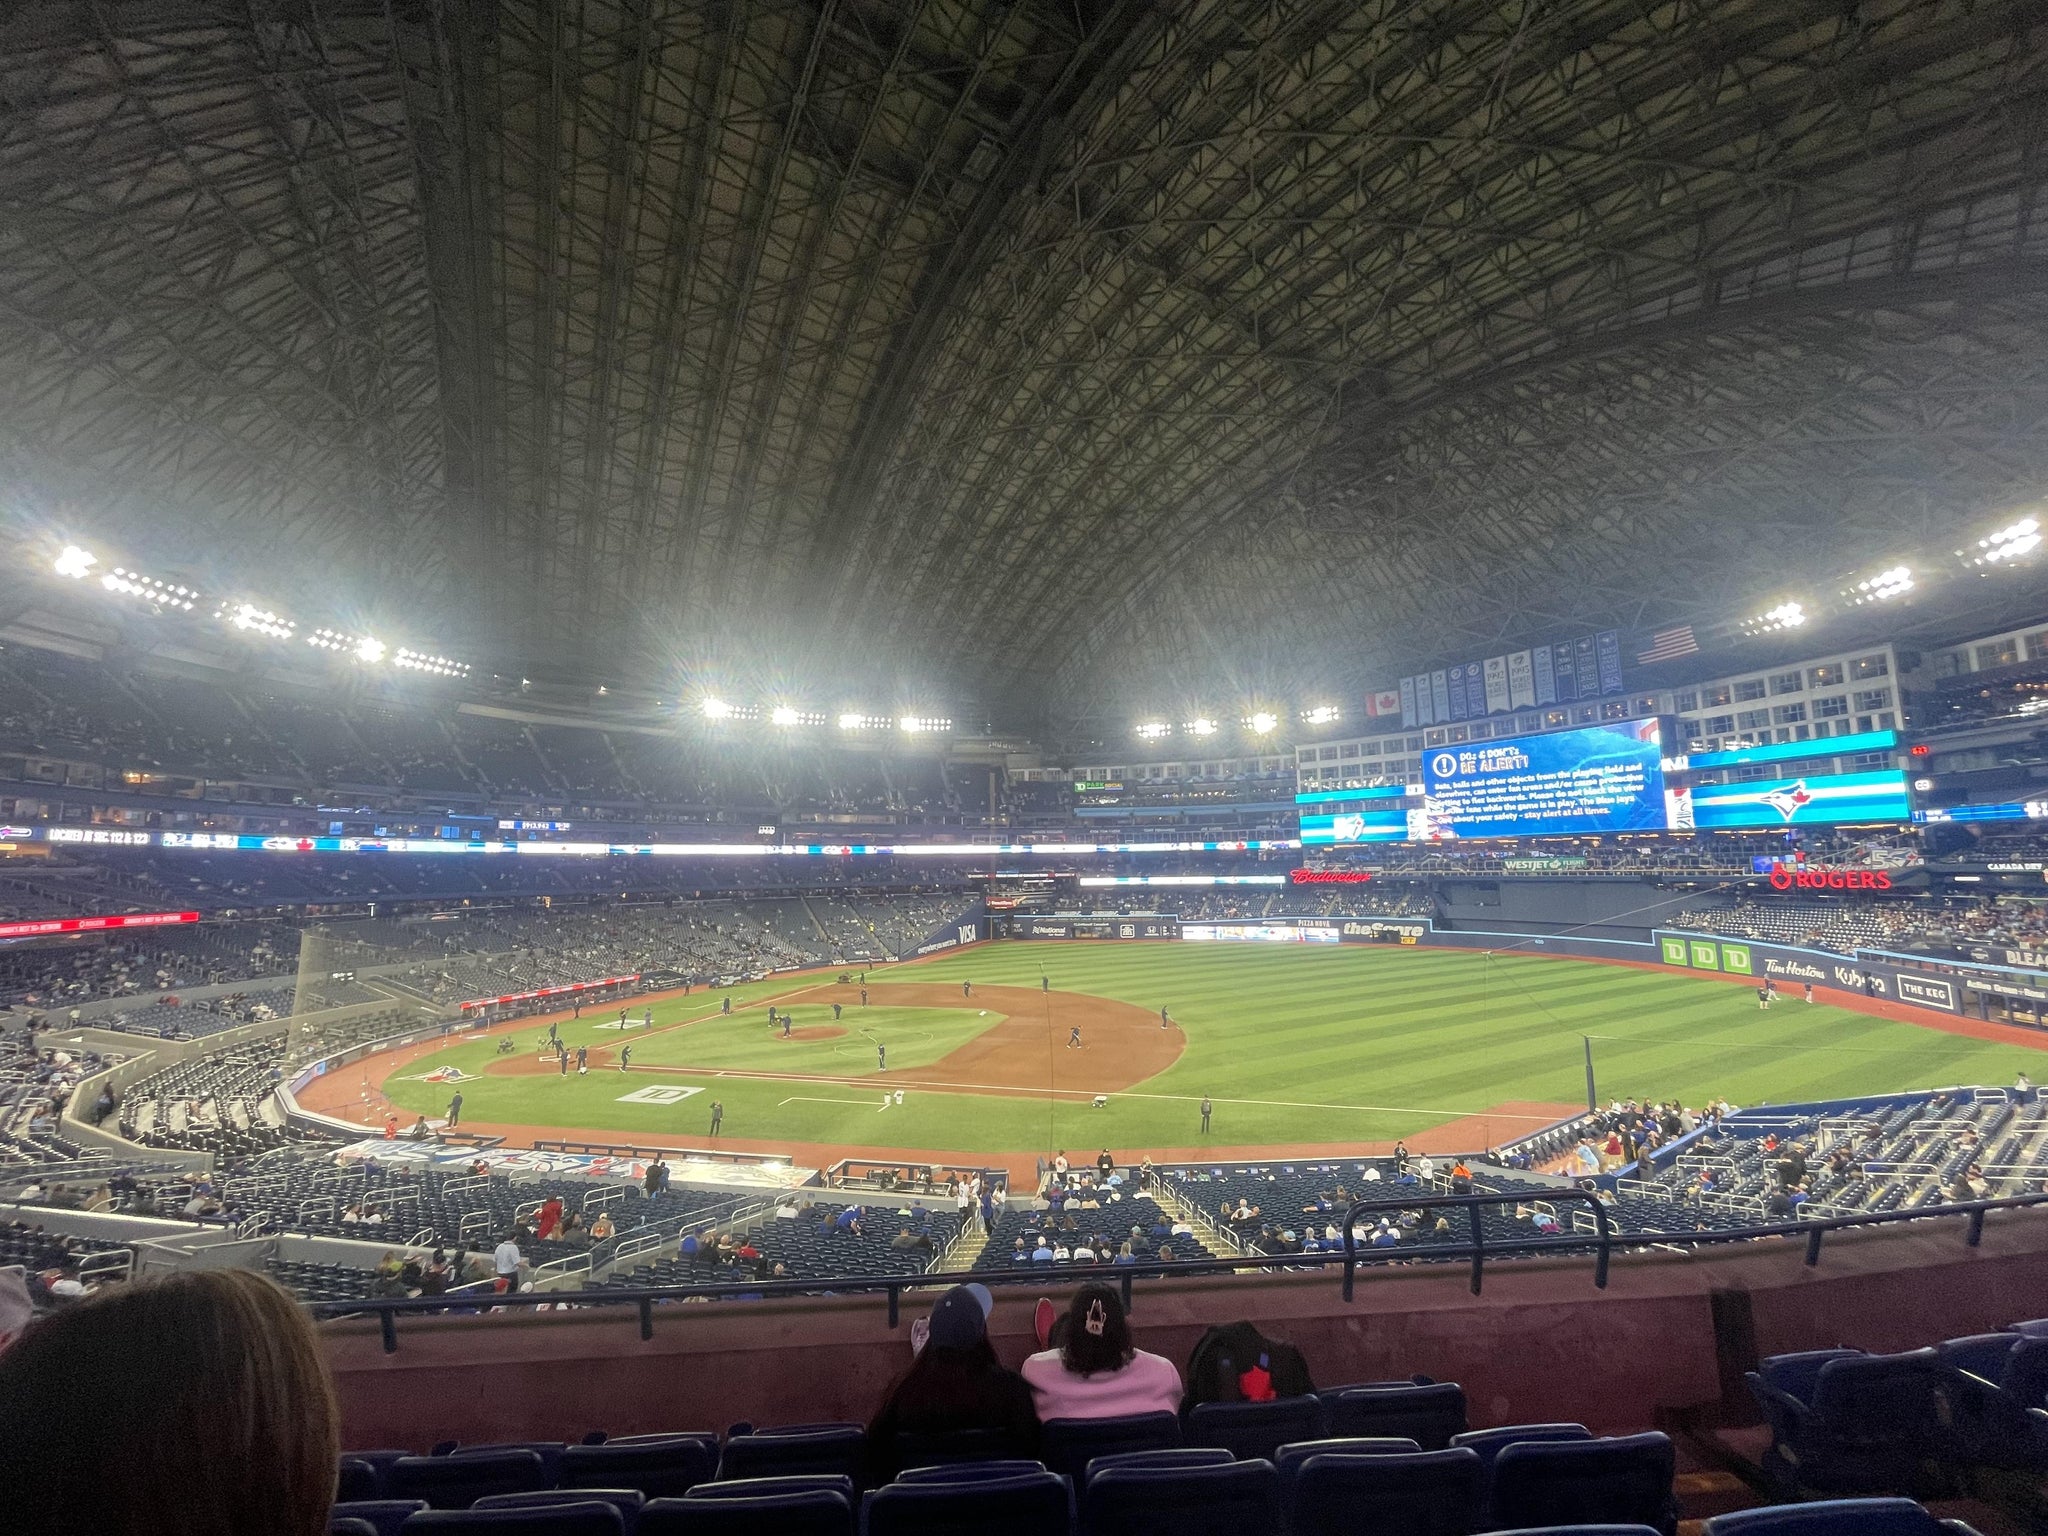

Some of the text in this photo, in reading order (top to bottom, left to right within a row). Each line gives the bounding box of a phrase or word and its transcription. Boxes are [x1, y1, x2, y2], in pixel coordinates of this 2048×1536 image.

[1460, 755, 1529, 774] BE ALERT!
[1453, 781, 1470, 789] balls
[1471, 779, 1485, 787] and
[1486, 777, 1507, 786] other
[1507, 775, 1535, 784] objects
[1536, 772, 1556, 781] from
[1557, 770, 1571, 779] the
[1572, 767, 1603, 779] playing
[1604, 764, 1624, 773] field
[1625, 762, 1643, 771] and
[1435, 789, 1473, 798] elsewhere,
[1487, 786, 1507, 794] enter
[1508, 784, 1521, 792] fan
[1522, 783, 1543, 791] areas
[1544, 780, 1572, 789] and/or
[1573, 779, 1598, 787] cause
[1599, 774, 1644, 786] protective
[1486, 794, 1528, 803] backwards.
[1529, 791, 1554, 800] Please
[1555, 789, 1567, 797] do
[1568, 788, 1583, 796] not
[1607, 785, 1622, 793] the
[1623, 784, 1644, 792] view
[1466, 805, 1482, 813] fans
[1482, 803, 1502, 812] while
[1504, 802, 1516, 810] the
[1517, 802, 1538, 811] game
[1557, 799, 1578, 809] play.
[1579, 797, 1594, 806] The
[1596, 796, 1615, 804] Blue
[1616, 794, 1635, 804] Jays
[1453, 815, 1474, 823] about
[1475, 815, 1493, 824] your
[1494, 812, 1518, 822] safety
[1524, 811, 1541, 820] stay
[1542, 808, 1561, 817] alert
[1563, 808, 1572, 816] at
[1573, 807, 1583, 815] all
[1584, 806, 1611, 815] times.
[1504, 860, 1550, 871] WESTJET
[1289, 868, 1371, 884] Budweiser
[1796, 871, 1892, 890] ROGERS
[958, 924, 977, 944] VISA
[1039, 926, 1066, 934] National
[1665, 943, 1684, 960] TD
[1694, 947, 1714, 964] TD
[1723, 950, 1748, 968] TD
[1764, 959, 1826, 980] Tim Hortons
[1904, 983, 1946, 999] THE KEG
[640, 1088, 689, 1099] TD
